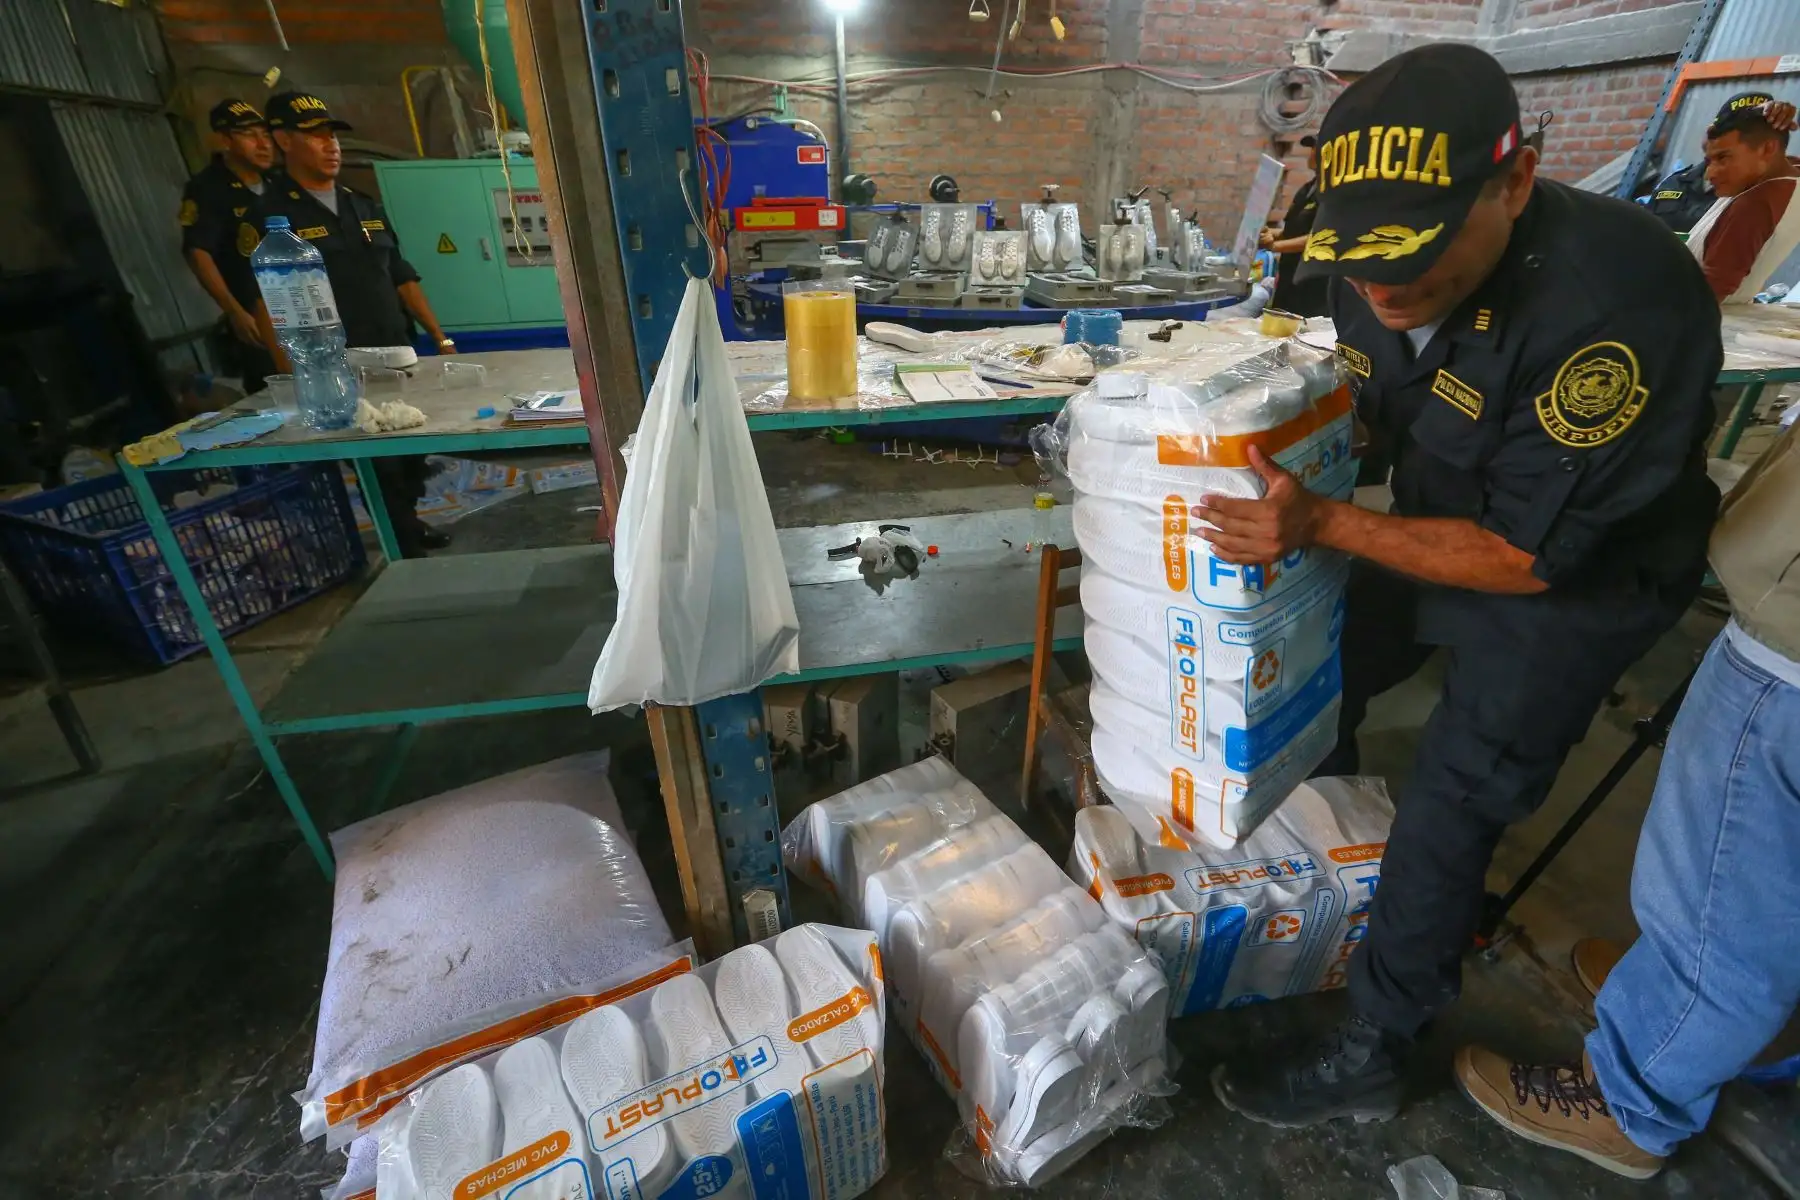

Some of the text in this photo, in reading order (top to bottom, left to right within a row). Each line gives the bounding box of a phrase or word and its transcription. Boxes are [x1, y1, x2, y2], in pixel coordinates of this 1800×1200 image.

[1319, 126, 1452, 193] POLICIA
[1167, 505, 1182, 582] PVC CABLES
[791, 1003, 850, 1037] CALZADOS
[603, 1046, 768, 1140] FACOPLAST
[465, 1138, 558, 1195] PVC MECHAS
